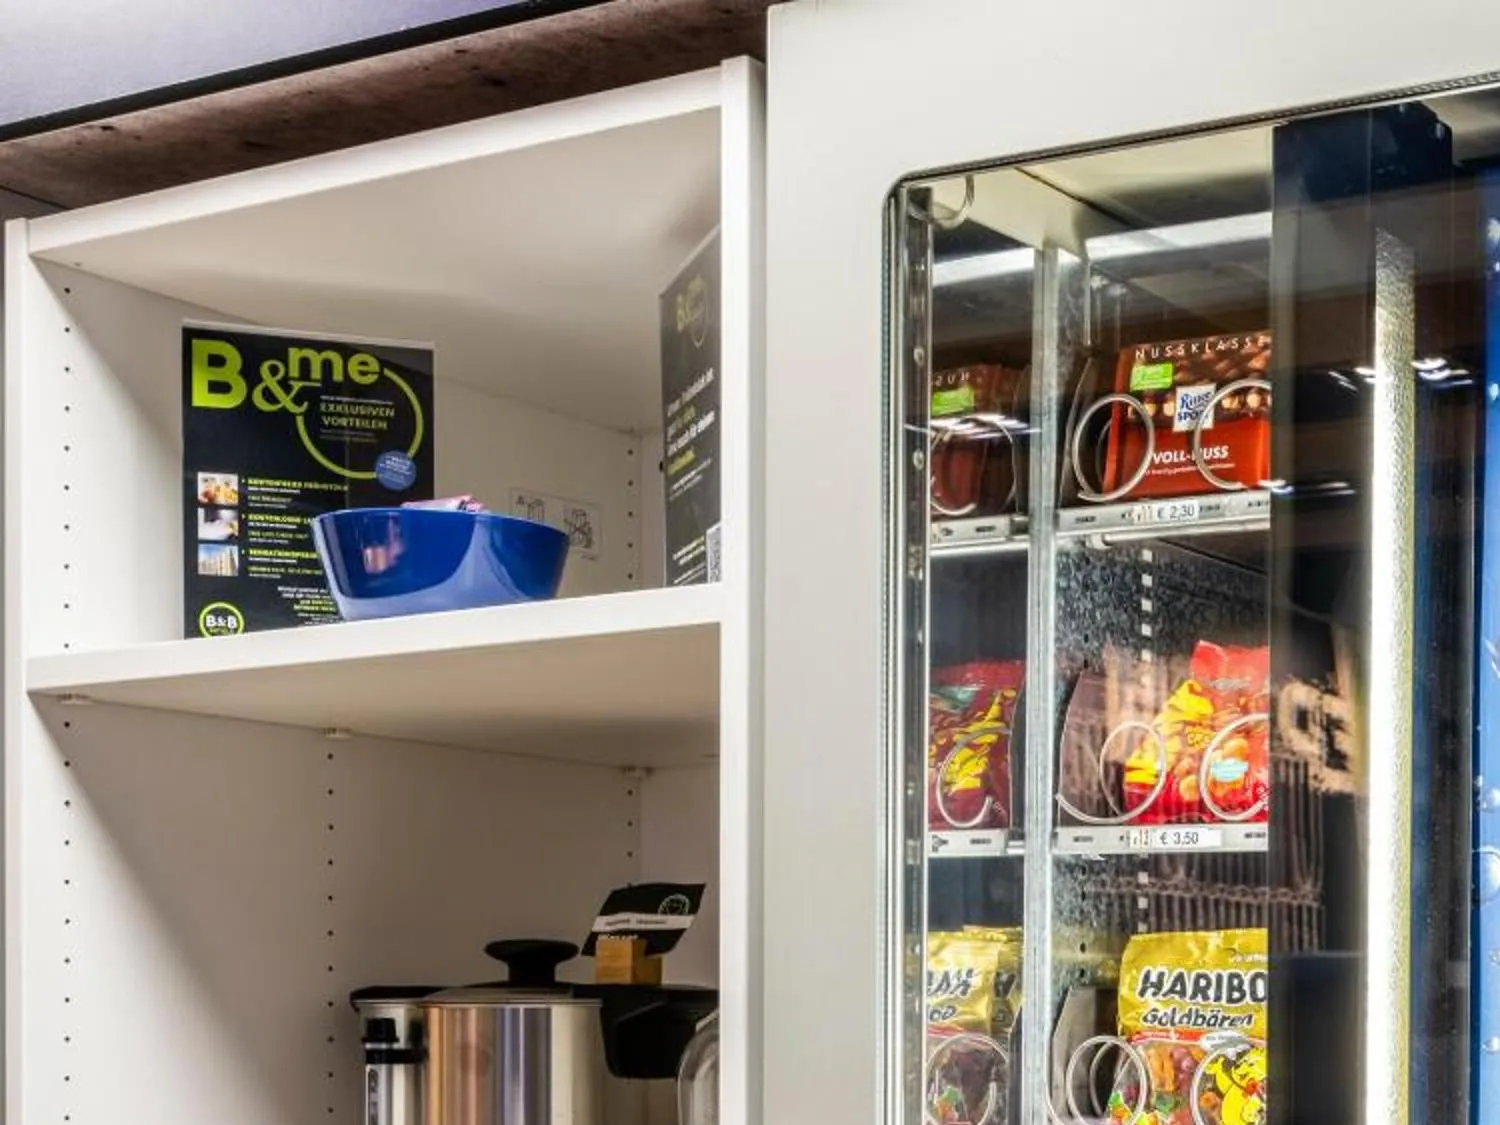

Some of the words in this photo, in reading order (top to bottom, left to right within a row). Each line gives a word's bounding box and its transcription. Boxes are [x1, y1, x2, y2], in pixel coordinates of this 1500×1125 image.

[320, 402, 394, 417] EXKLUSIVEN
[205, 615, 238, 628] B&B
[1137, 968, 1267, 1005] HARIBO
[1141, 1006, 1254, 1029] Goldbären
